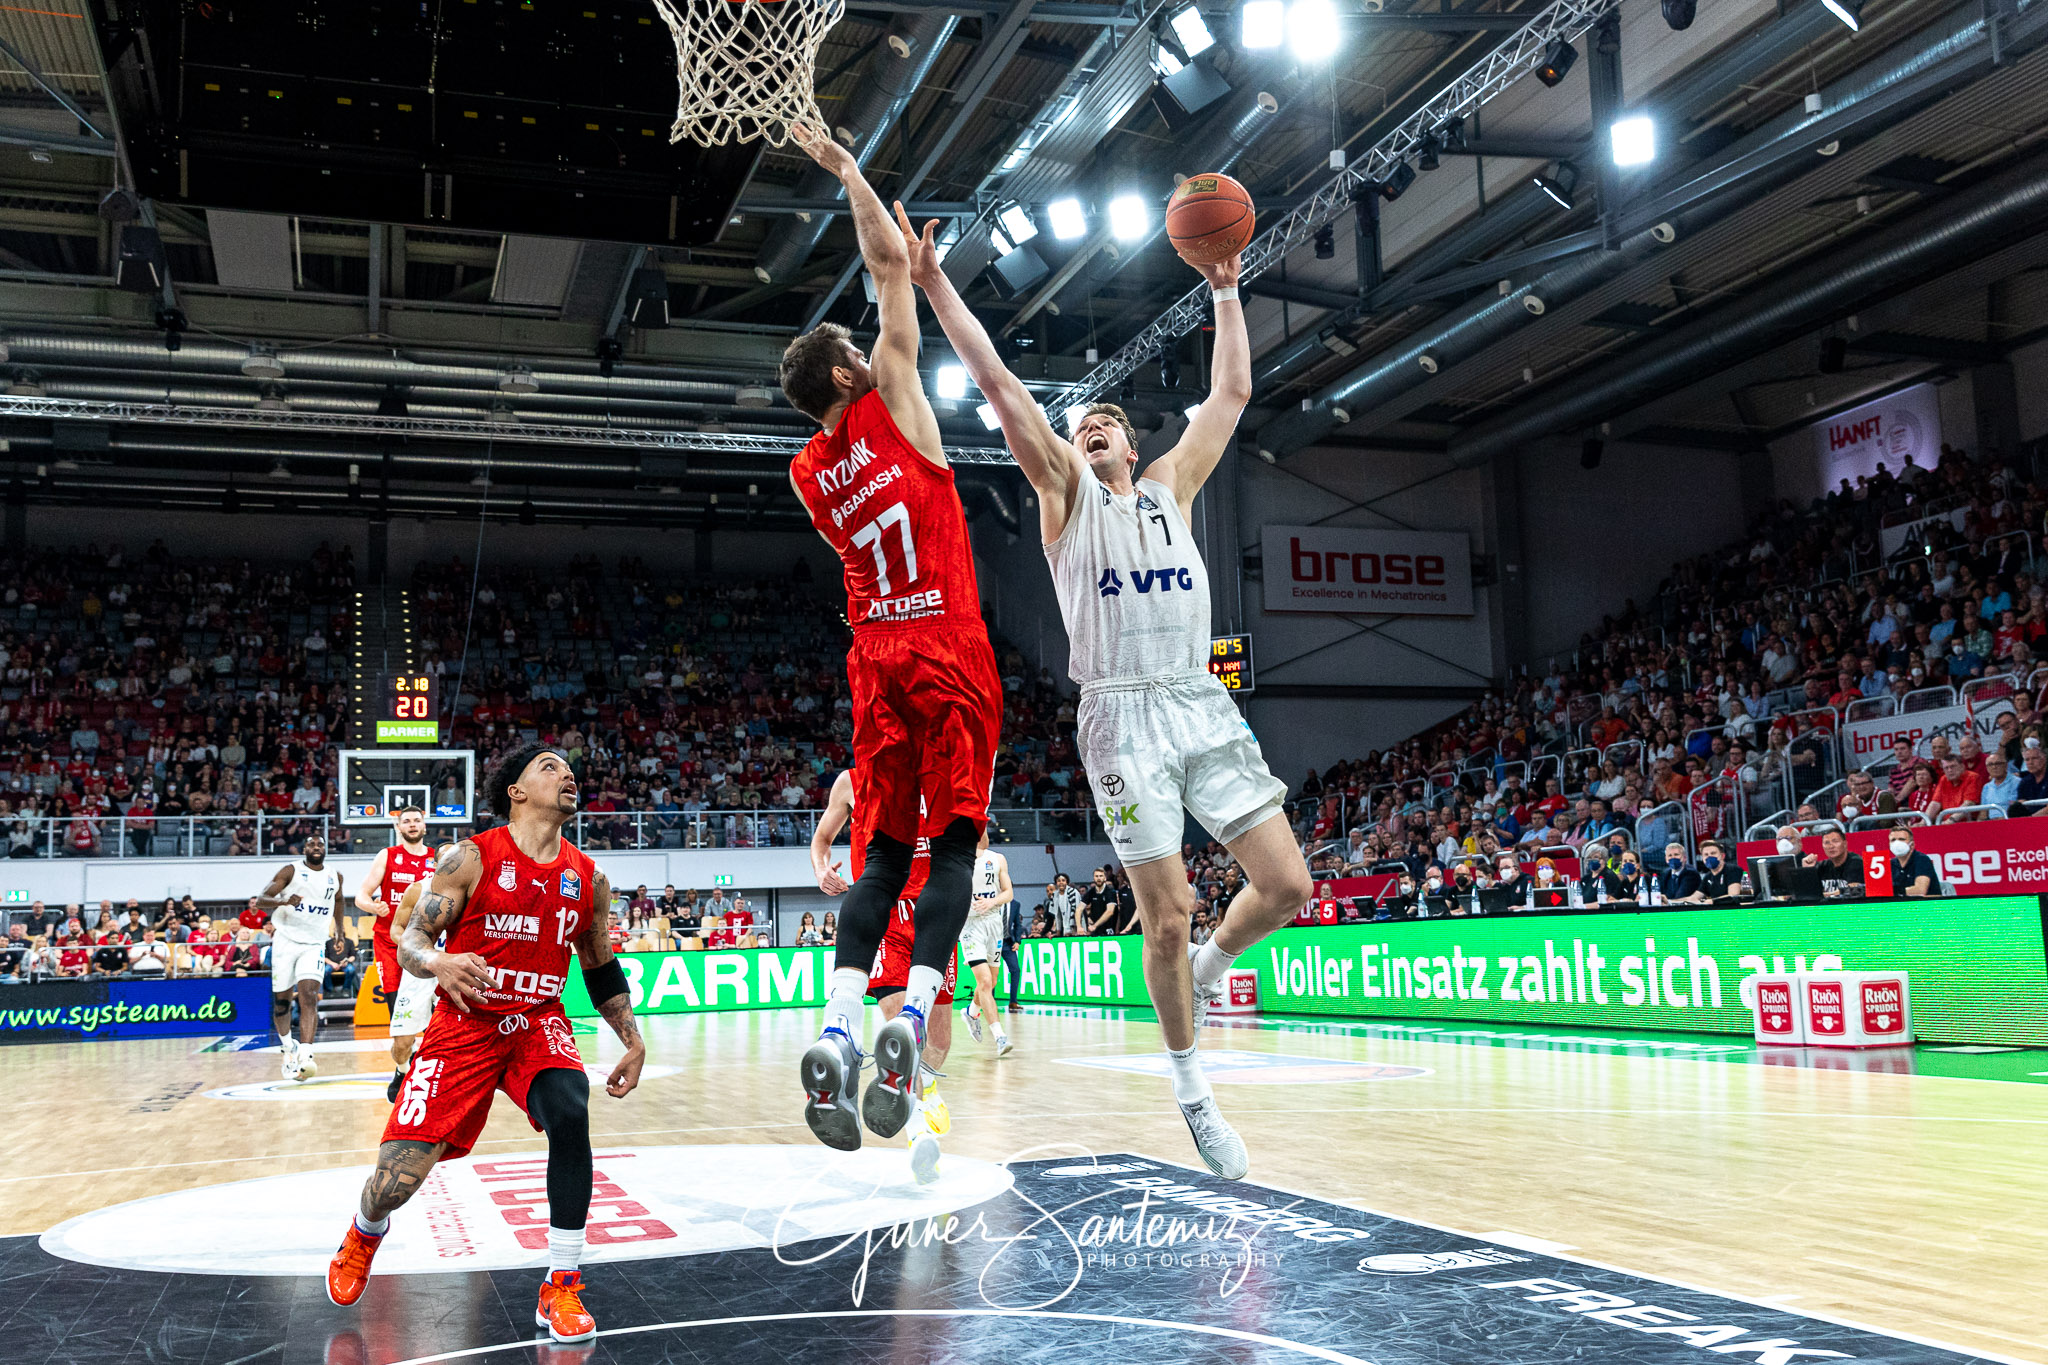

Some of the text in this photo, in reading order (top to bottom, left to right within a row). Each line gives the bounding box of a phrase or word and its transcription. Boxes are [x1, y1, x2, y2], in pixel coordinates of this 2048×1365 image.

[1829, 415, 1881, 451] HANFT
[842, 464, 903, 519] IGARASHI
[1149, 514, 1172, 546] 7
[850, 501, 918, 597] 77
[1290, 537, 1445, 586] brose
[1130, 567, 1193, 594] VTG
[1292, 587, 1447, 602] Excellence in Mechatronics
[868, 589, 943, 618] brose
[1223, 661, 1240, 671] HAM
[1220, 672, 1241, 689] 45
[396, 696, 428, 718] 20
[379, 727, 435, 737] BARMER
[1869, 856, 1885, 879] 5
[324, 888, 334, 900] 17
[308, 905, 329, 915] VTG
[1323, 904, 1333, 918] 5
[485, 914, 523, 933] LVM
[556, 907, 579, 947] 12
[484, 931, 538, 942] VERSICHERUNG
[1271, 945, 1353, 997] Voller
[1361, 943, 1489, 1000] Einsatz
[1499, 938, 1602, 1004] zahlt
[1620, 937, 1722, 1008] sich
[514, 994, 523, 1002] in
[1761, 989, 1787, 1004] RHÖN
[1811, 988, 1839, 1004] RHÖN
[1864, 987, 1898, 1003] RHÖN
[1762, 1004, 1789, 1013] SPRUDEL
[1812, 1004, 1841, 1014] SPRUDEL
[1865, 1003, 1899, 1013] SPRUDEL
[431, 1080, 439, 1097] rent
[1109, 1177, 1371, 1243] BAMBERG
[1479, 1277, 1858, 1365] FREAK
